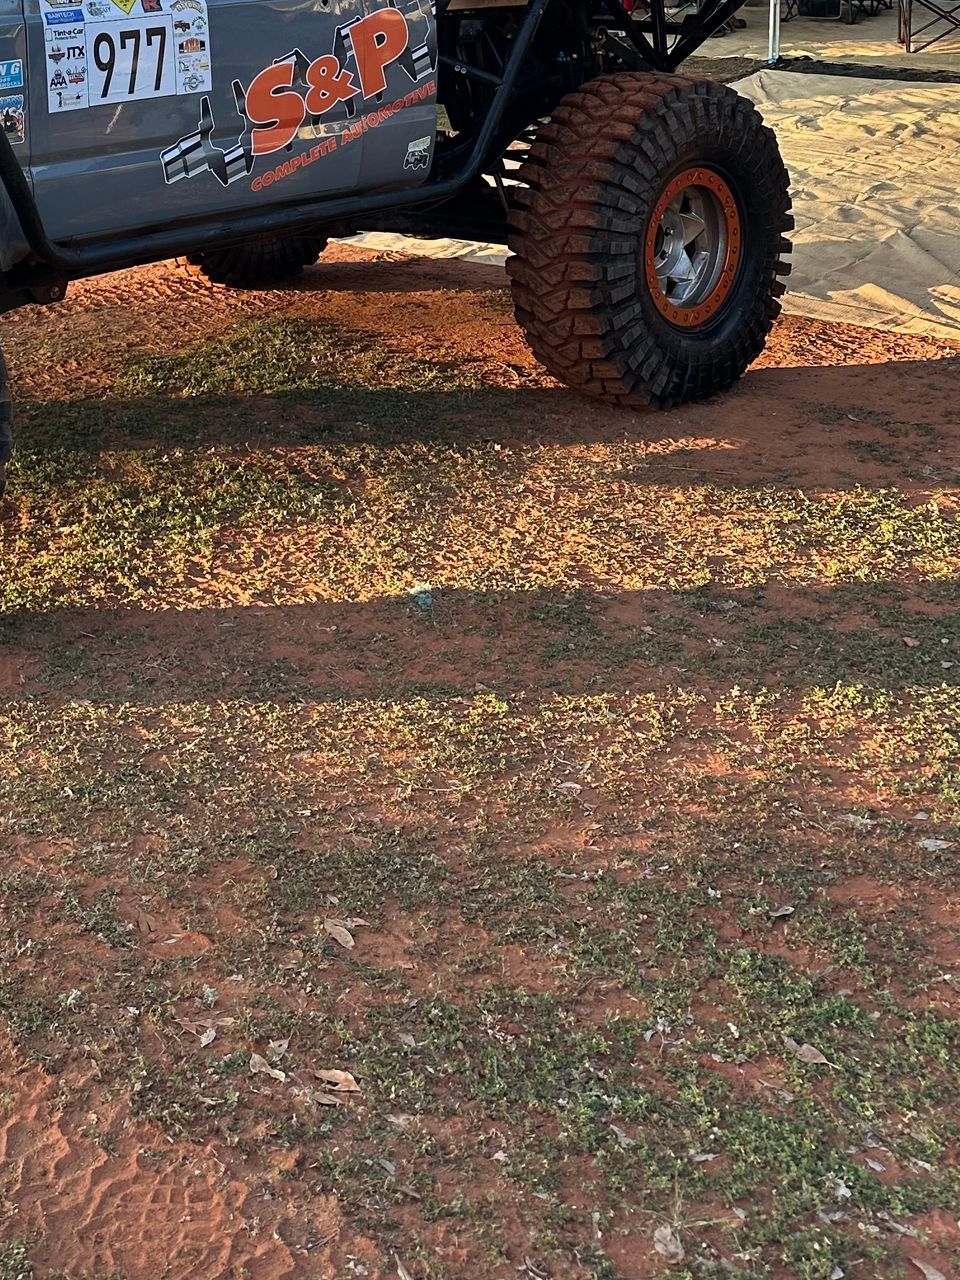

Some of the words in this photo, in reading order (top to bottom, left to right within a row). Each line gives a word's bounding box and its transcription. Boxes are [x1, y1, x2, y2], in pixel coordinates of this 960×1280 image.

[66, 45, 85, 60] JTX
[93, 26, 167, 99] 977
[245, 7, 409, 155] S&P
[250, 136, 337, 192] COMPLETE
[340, 79, 437, 146] AUTOMOTIVE
